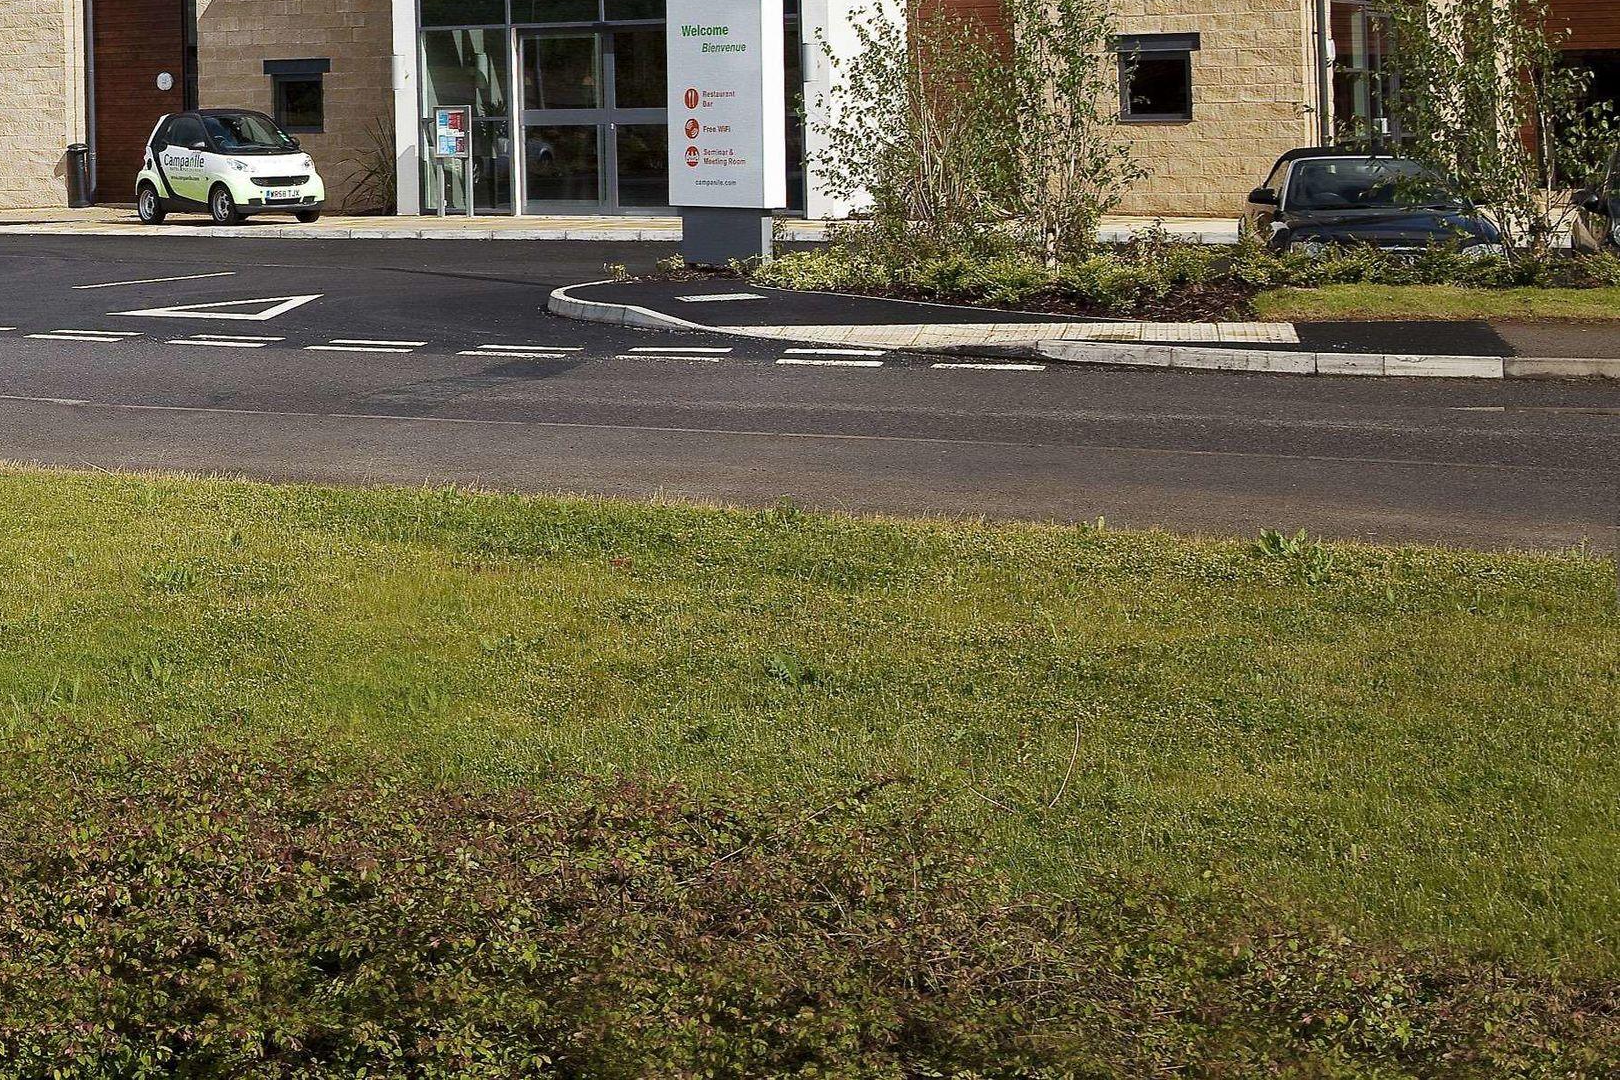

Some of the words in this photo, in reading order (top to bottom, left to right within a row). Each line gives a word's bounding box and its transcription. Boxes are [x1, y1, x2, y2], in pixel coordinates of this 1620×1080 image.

[681, 24, 729, 37] Welcome
[701, 42, 747, 53] Bienvenue
[702, 90, 736, 98] Restaurant
[702, 100, 714, 108] Bar
[702, 125, 716, 133] Free
[703, 148, 728, 156] Seminar
[163, 153, 205, 171] Campanile
[703, 157, 728, 166] Meeting
[728, 157, 747, 165] Room
[695, 179, 737, 187] campanile.com
